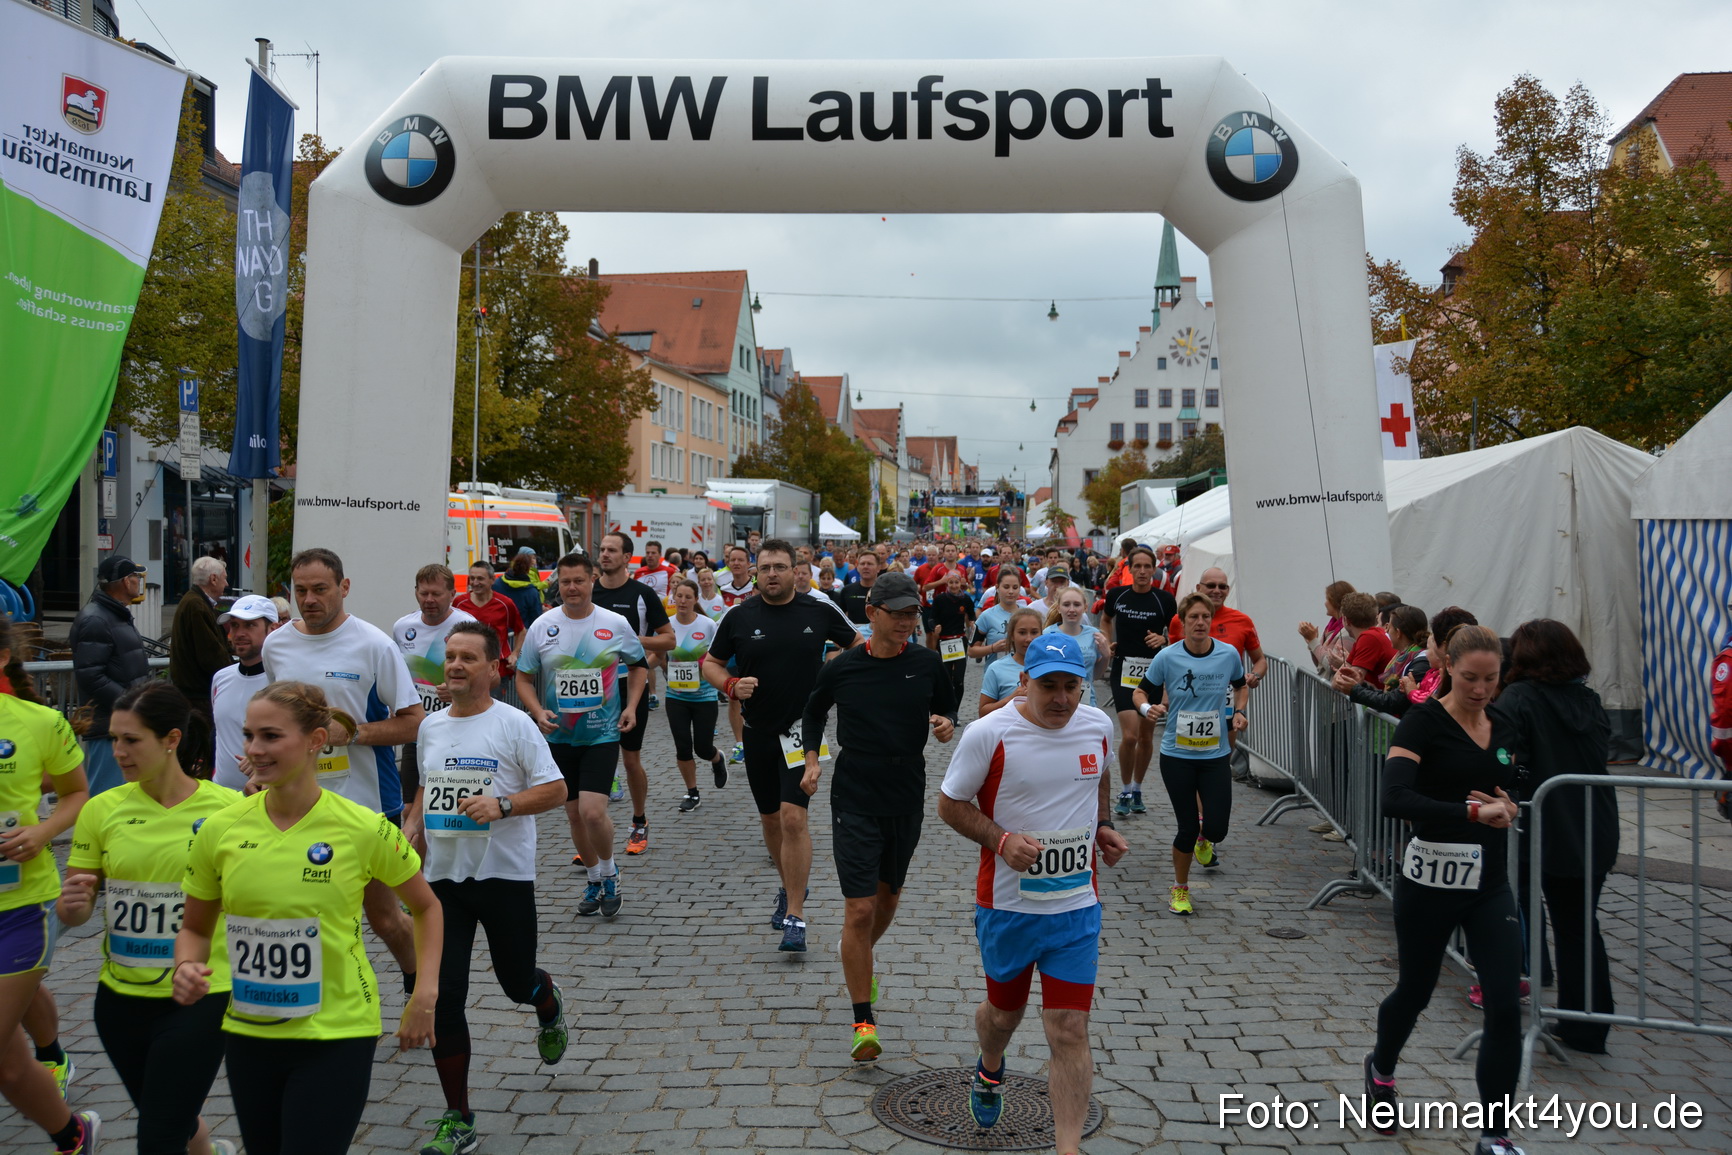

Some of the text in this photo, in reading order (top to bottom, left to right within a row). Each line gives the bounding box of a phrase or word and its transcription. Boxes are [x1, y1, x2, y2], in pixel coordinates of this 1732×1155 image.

[488, 74, 1174, 157] BMW Laufsport
[376, 117, 447, 145] BMW
[1215, 113, 1287, 142] BMW
[183, 380, 194, 406] P
[106, 437, 114, 471] P
[136, 492, 142, 507] 3
[297, 496, 421, 511] www.bmw-laufsport.de
[1256, 490, 1383, 508] www.bmw-laufsport.de
[947, 644, 957, 653] 61
[674, 669, 693, 680] 105
[560, 679, 599, 696] 2649
[1187, 721, 1214, 736] 142
[0, 761, 16, 770] artl
[318, 761, 332, 770] ard
[444, 818, 462, 828] Udo
[1050, 836, 1084, 845] Neumarkt
[1432, 849, 1469, 858] Neumarkt
[303, 868, 332, 878] Partl
[1410, 855, 1474, 886] 3107
[108, 886, 184, 899] PARTL Neumarkt
[114, 900, 185, 934] 2013
[227, 924, 301, 938] PARTL Neumarkt
[125, 941, 170, 956] Nadine
[236, 940, 311, 979] 2499
[244, 985, 299, 1004] Franziska
